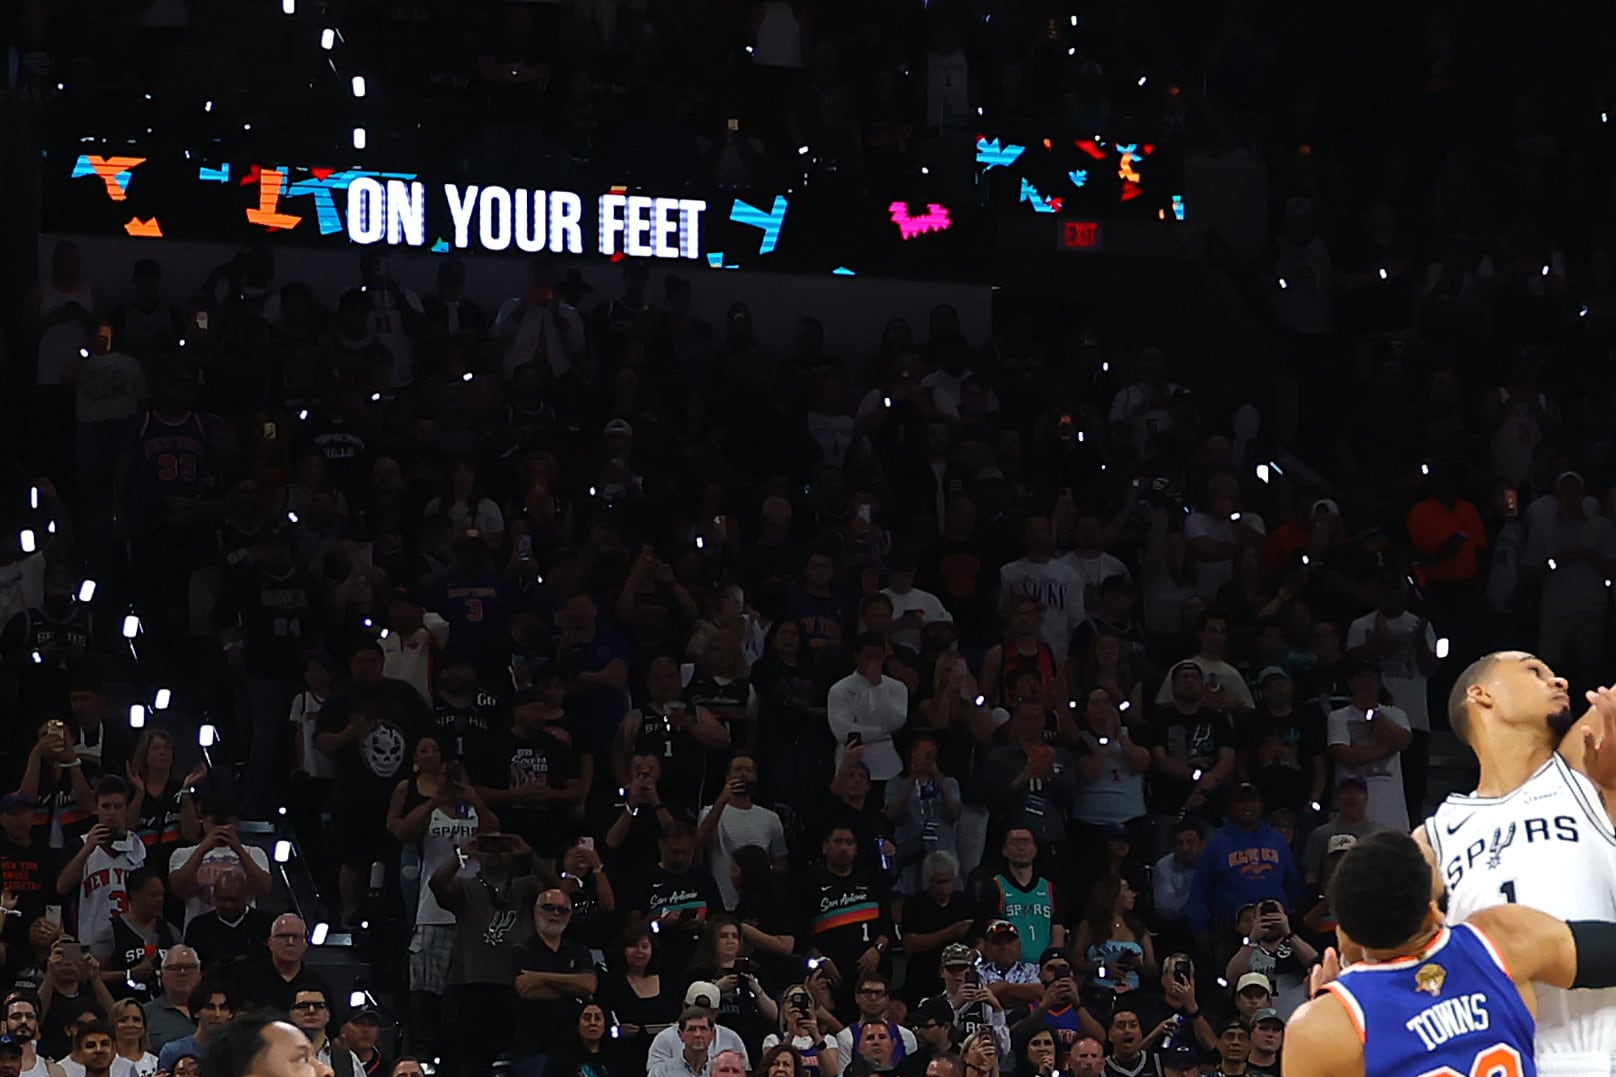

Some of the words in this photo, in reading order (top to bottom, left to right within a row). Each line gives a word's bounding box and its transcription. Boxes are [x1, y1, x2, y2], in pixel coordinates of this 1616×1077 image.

[348, 177, 424, 247] ON
[446, 184, 583, 254] YOUR
[600, 193, 706, 260] FEET
[1446, 816, 1580, 893] SPURS
[861, 922, 870, 942] 1
[1405, 992, 1490, 1052] TOWNS
